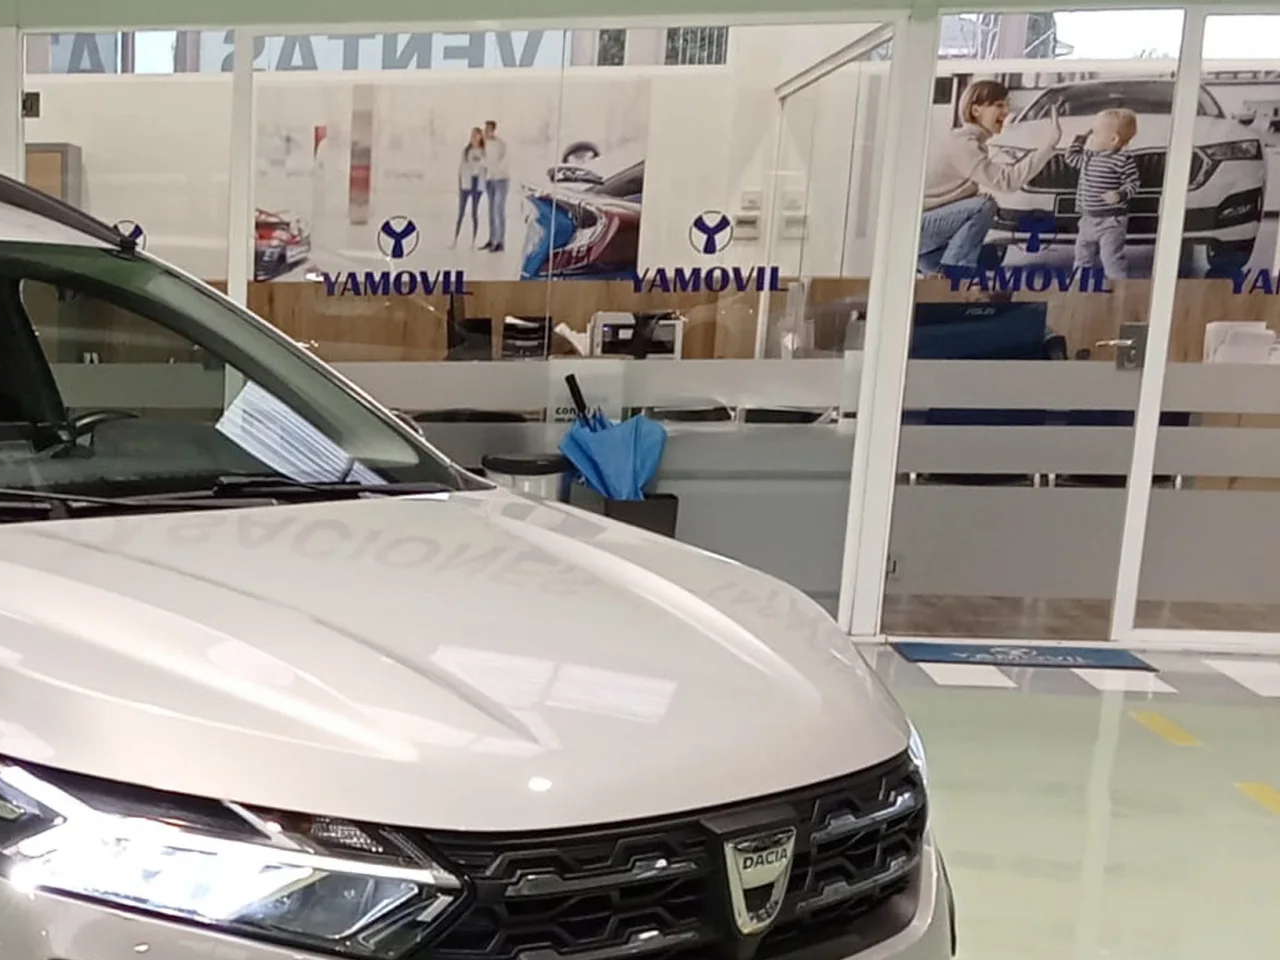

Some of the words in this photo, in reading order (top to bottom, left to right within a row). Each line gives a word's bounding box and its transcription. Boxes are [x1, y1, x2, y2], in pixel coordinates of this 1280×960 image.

[322, 270, 474, 296] YAMOVIL
[632, 266, 789, 293] YAMOVIL
[942, 265, 1113, 293] YAMOVIL
[1226, 268, 1280, 295] YA
[743, 848, 788, 870] DACIA
